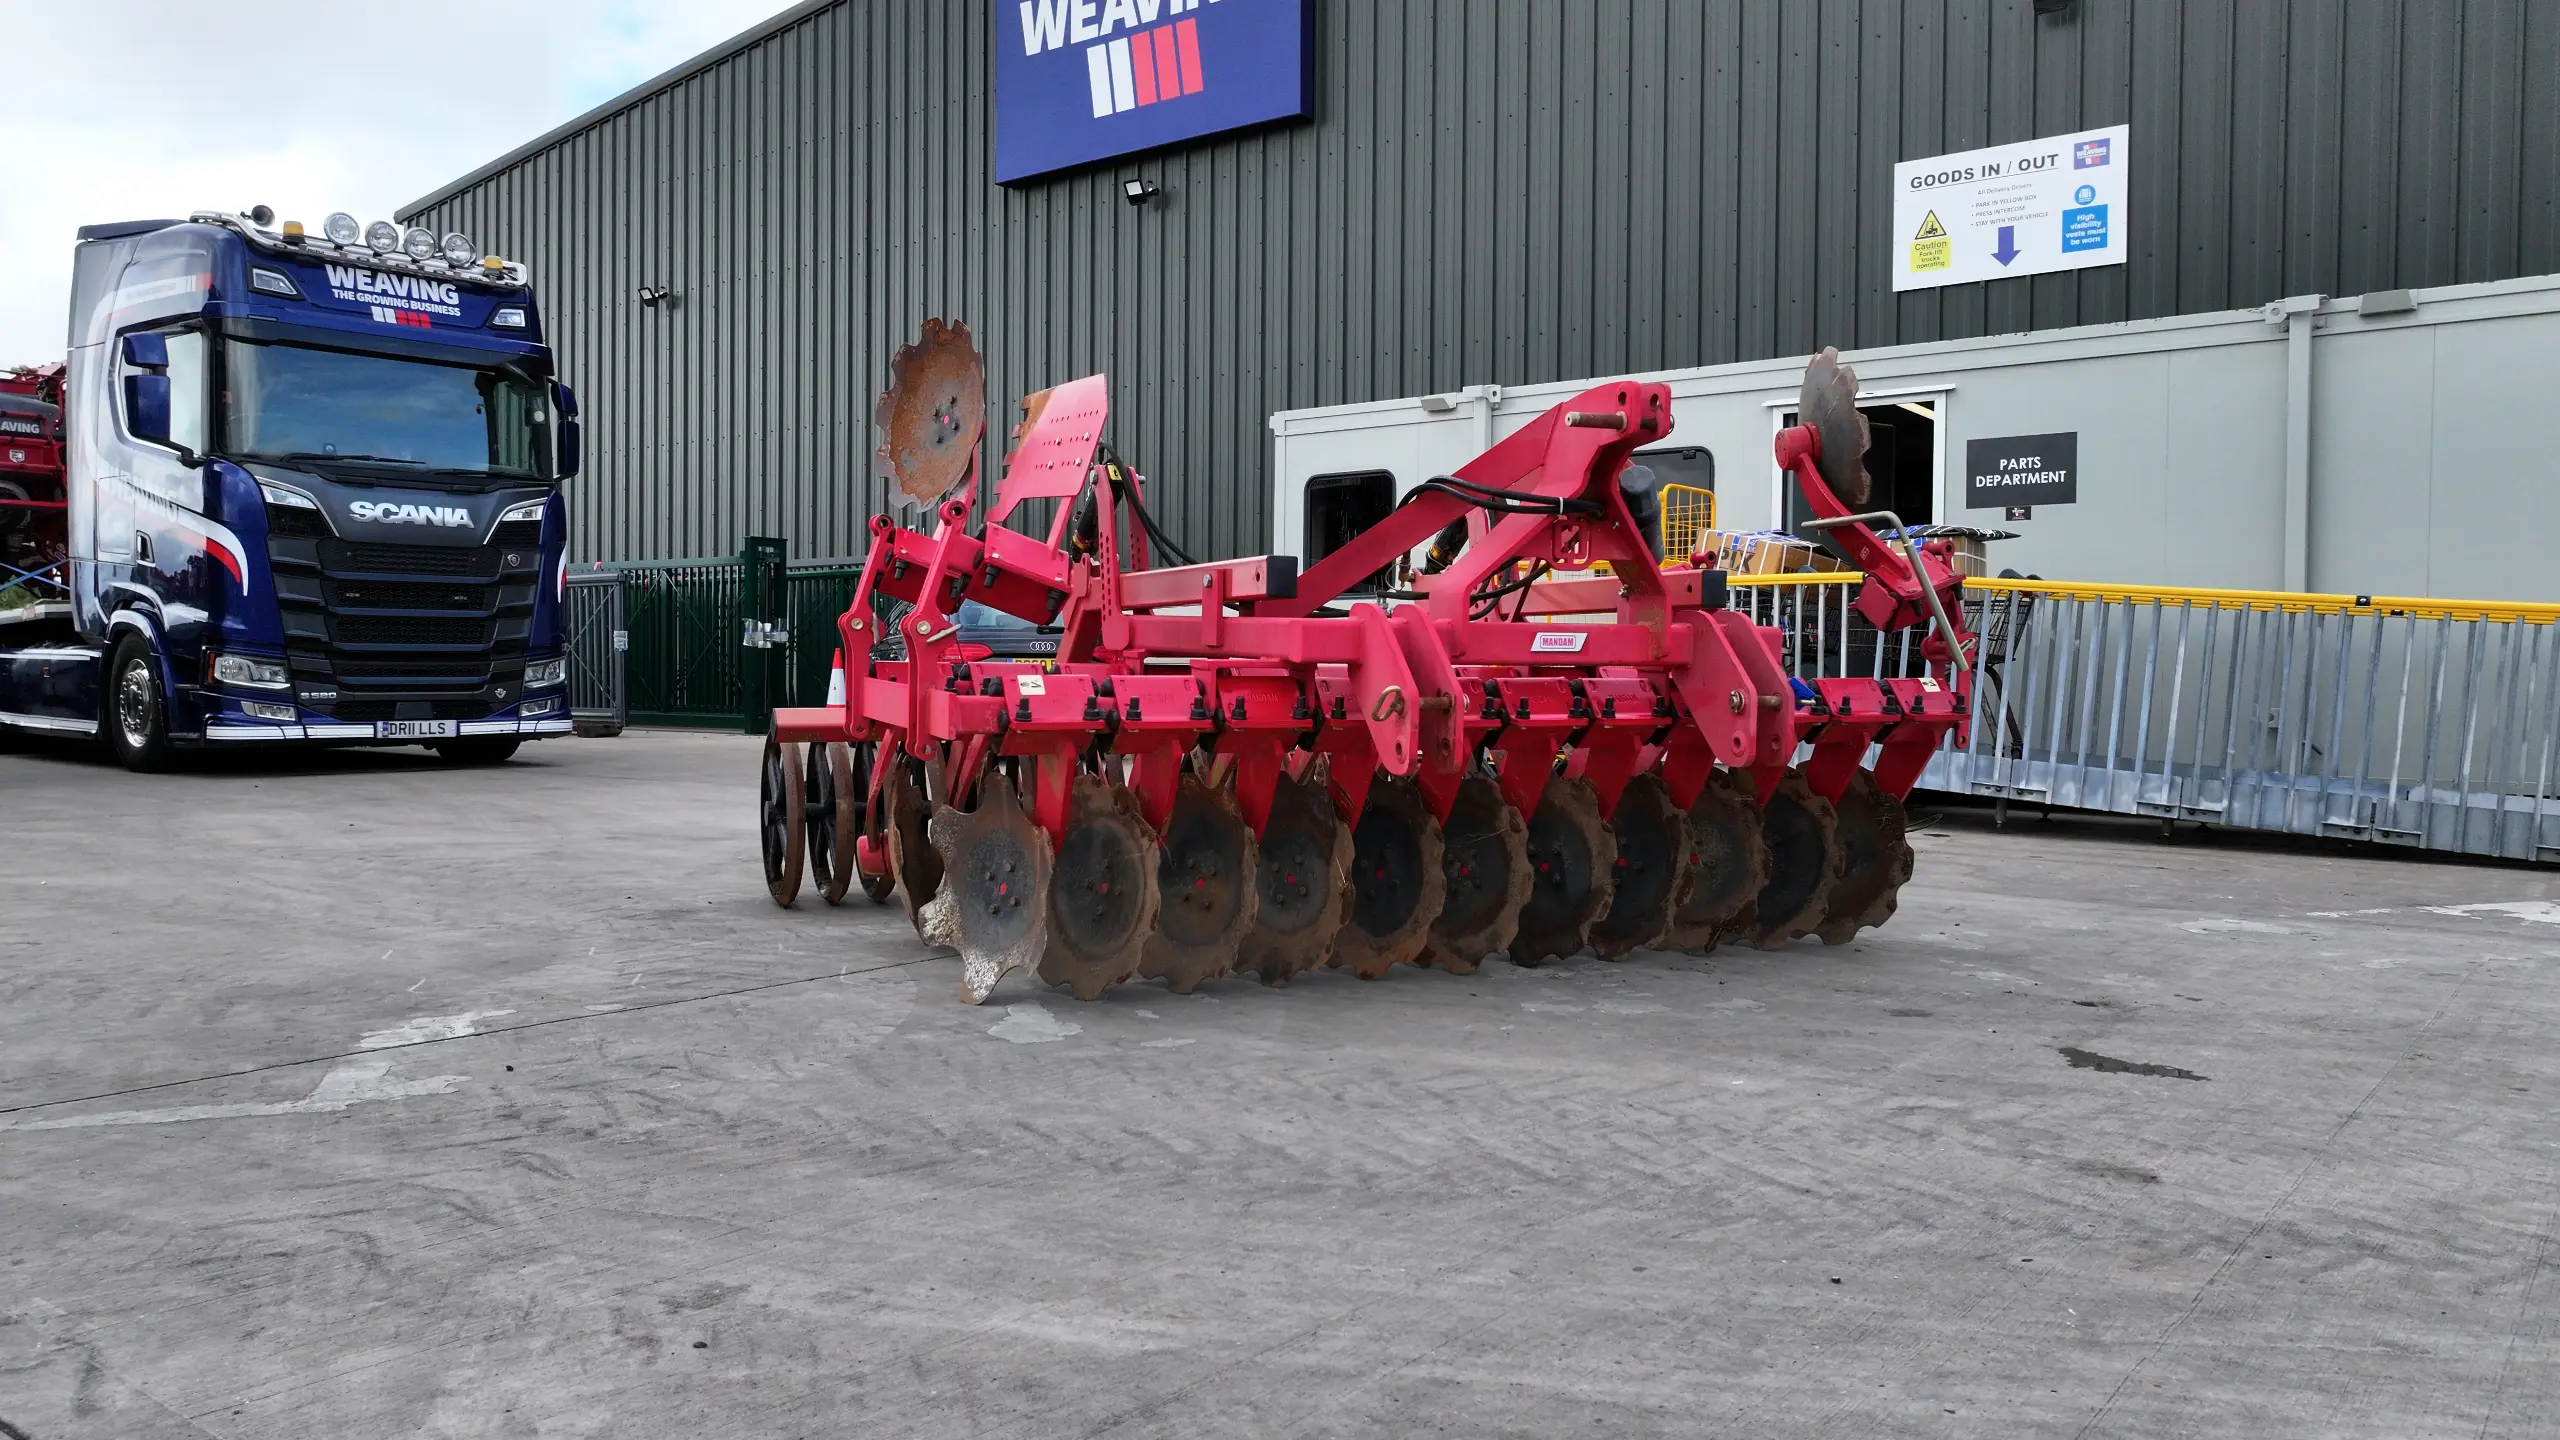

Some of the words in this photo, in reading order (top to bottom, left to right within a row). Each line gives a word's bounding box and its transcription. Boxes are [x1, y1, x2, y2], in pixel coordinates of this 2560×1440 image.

[1020, 0, 1222, 56] WEA
[1911, 167, 1974, 189] GOODS
[1981, 162, 2001, 178] IN
[2007, 160, 2012, 174] /
[2018, 153, 2059, 172] OUT
[1986, 186, 2010, 195] Delivery
[2000, 196, 2023, 204] YELLOW
[1994, 205, 2025, 214] INTERCOM
[1975, 219, 1989, 227] STAY
[1990, 217, 2006, 225] WITH
[2025, 211, 2049, 220] VEHICLE
[2077, 213, 2095, 222] High
[2070, 220, 2102, 230] visibility
[2065, 230, 2086, 239] vests
[2087, 227, 2106, 236] must
[1914, 240, 1947, 251] Caution
[2070, 237, 2081, 246] be
[2082, 235, 2101, 244] worn
[1919, 249, 1943, 257] Fork-lift
[1921, 255, 1941, 263] trucks
[1916, 260, 1946, 270] operating
[325, 264, 460, 305] WEAVING
[332, 288, 356, 301] THE
[357, 292, 409, 309] GROWING
[410, 300, 461, 317] BUSINESS
[1999, 456, 2042, 471] PARTS
[1975, 470, 2067, 488] DEPARTMENT
[349, 500, 475, 529] SCANIA
[1542, 637, 1574, 647] MANDAM
[419, 722, 446, 735] LLS
